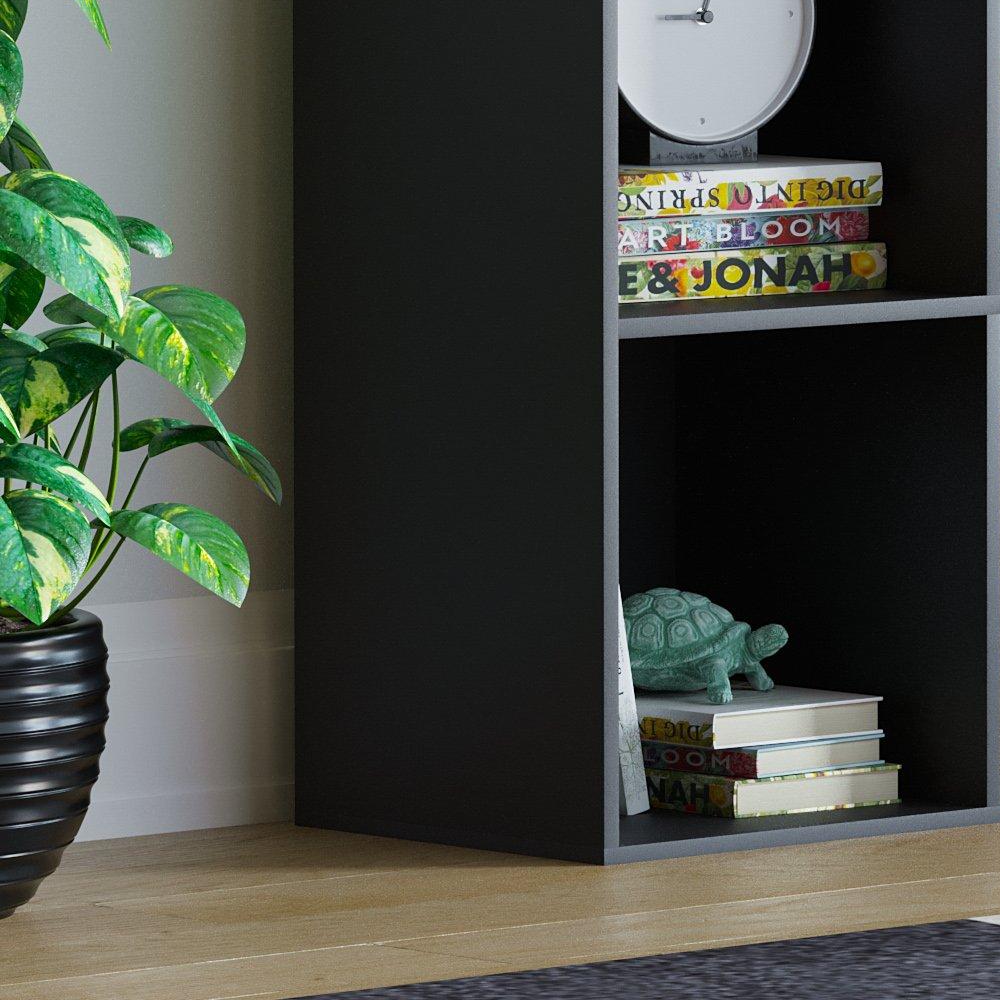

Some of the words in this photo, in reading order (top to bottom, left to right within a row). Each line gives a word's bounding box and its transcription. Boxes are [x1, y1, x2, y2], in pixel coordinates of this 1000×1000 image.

[735, 181, 810, 204] INTO
[817, 179, 866, 200] DIG
[716, 217, 843, 243] BLOOM
[647, 262, 681, 294] &
[694, 253, 851, 292] JONAH
[664, 721, 702, 740] DIG
